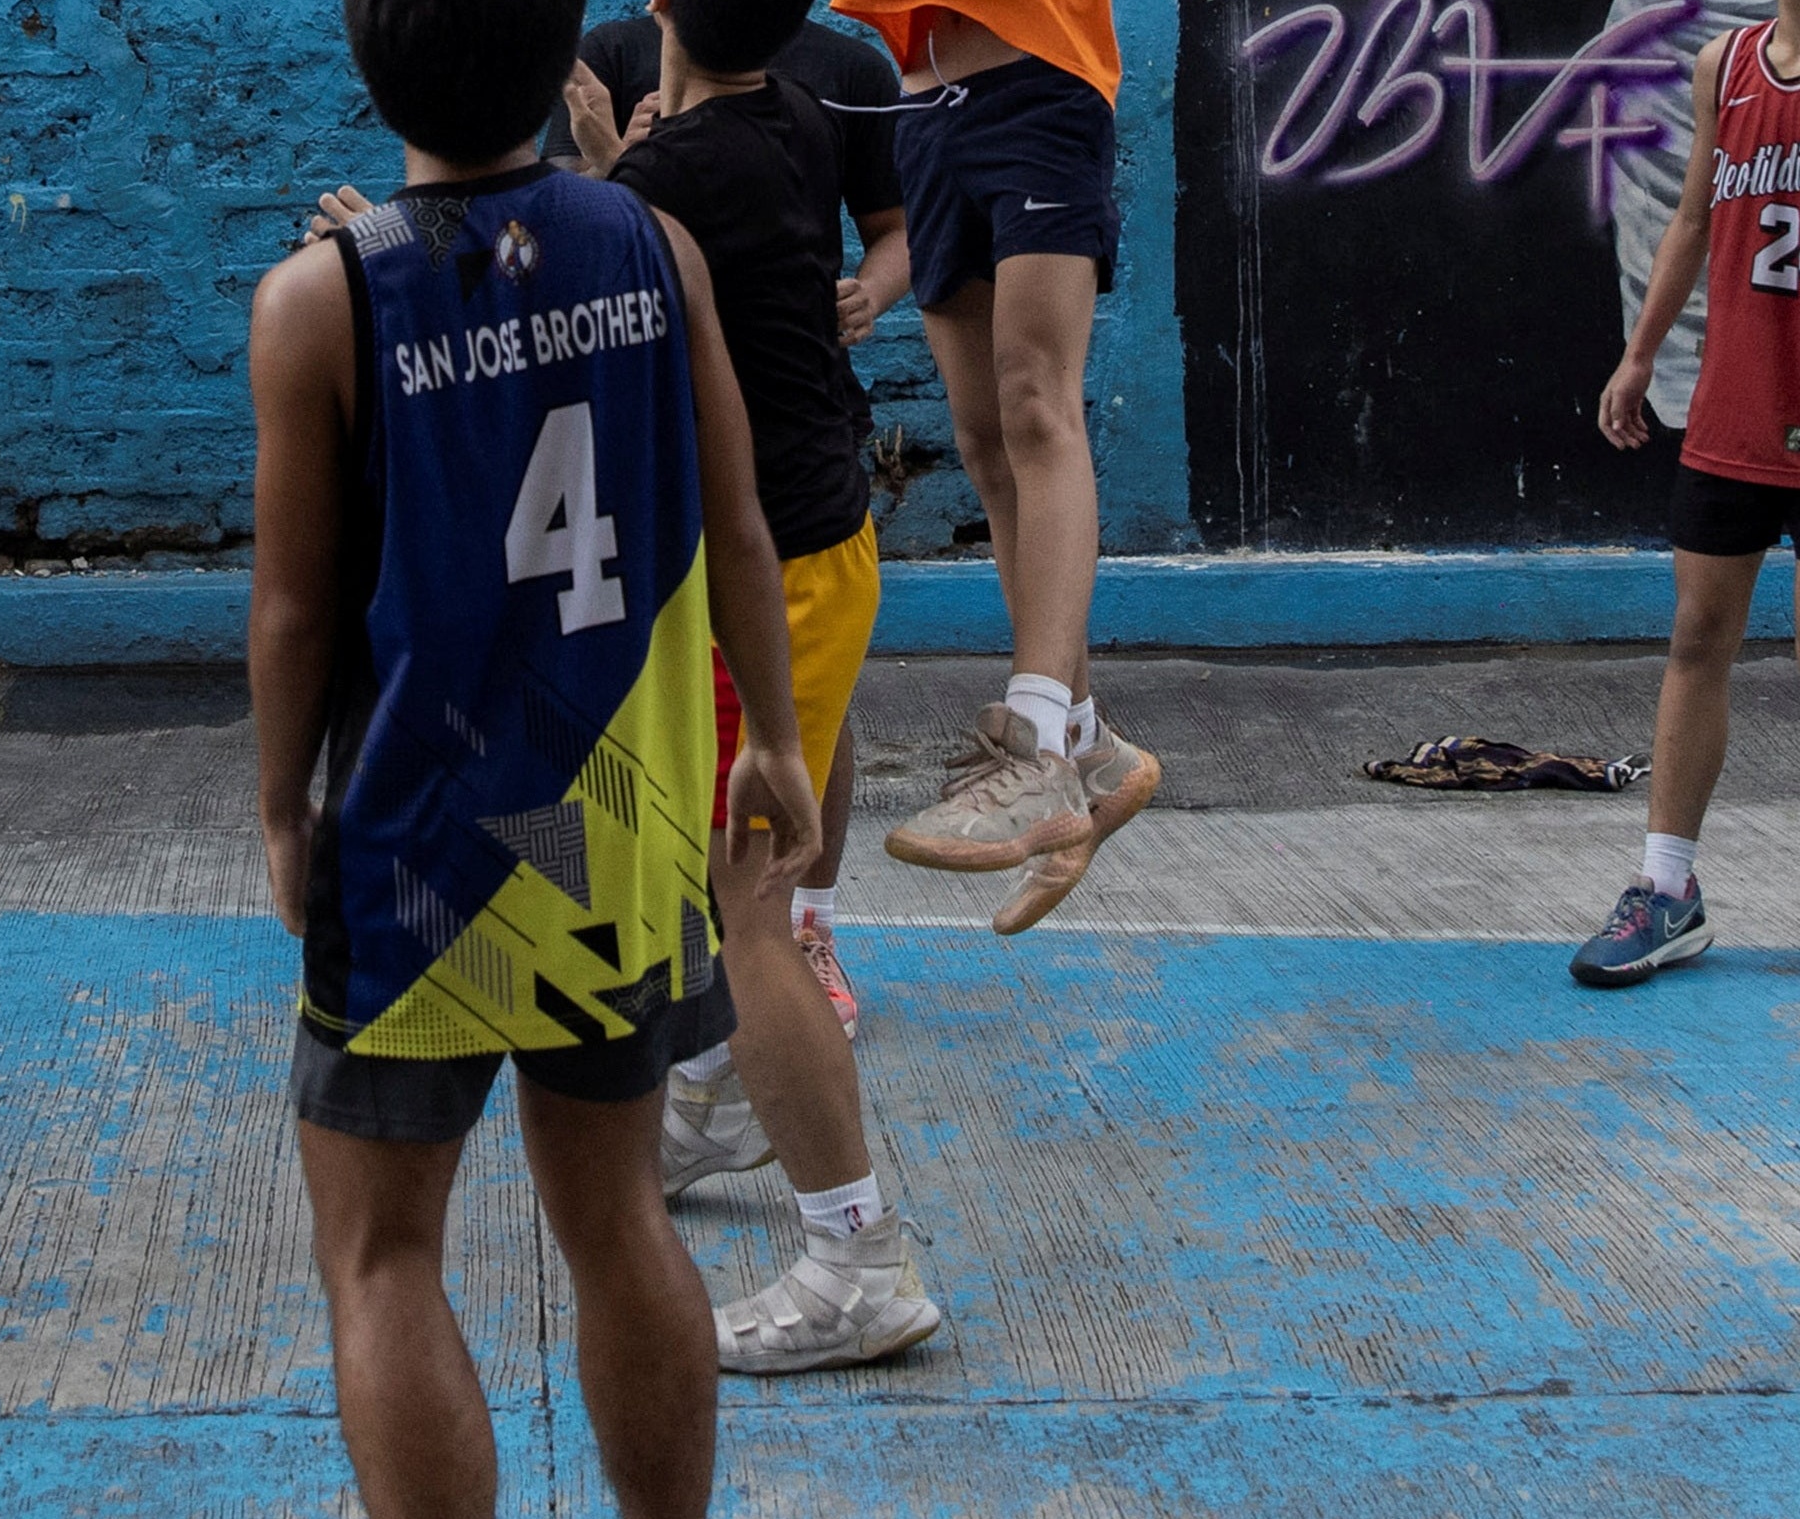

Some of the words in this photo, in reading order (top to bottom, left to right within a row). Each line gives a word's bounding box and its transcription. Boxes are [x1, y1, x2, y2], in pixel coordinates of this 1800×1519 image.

[395, 334, 456, 397] SAN
[463, 317, 528, 383] JOSE
[529, 286, 667, 366] BROTHERS
[504, 400, 626, 637] 4
